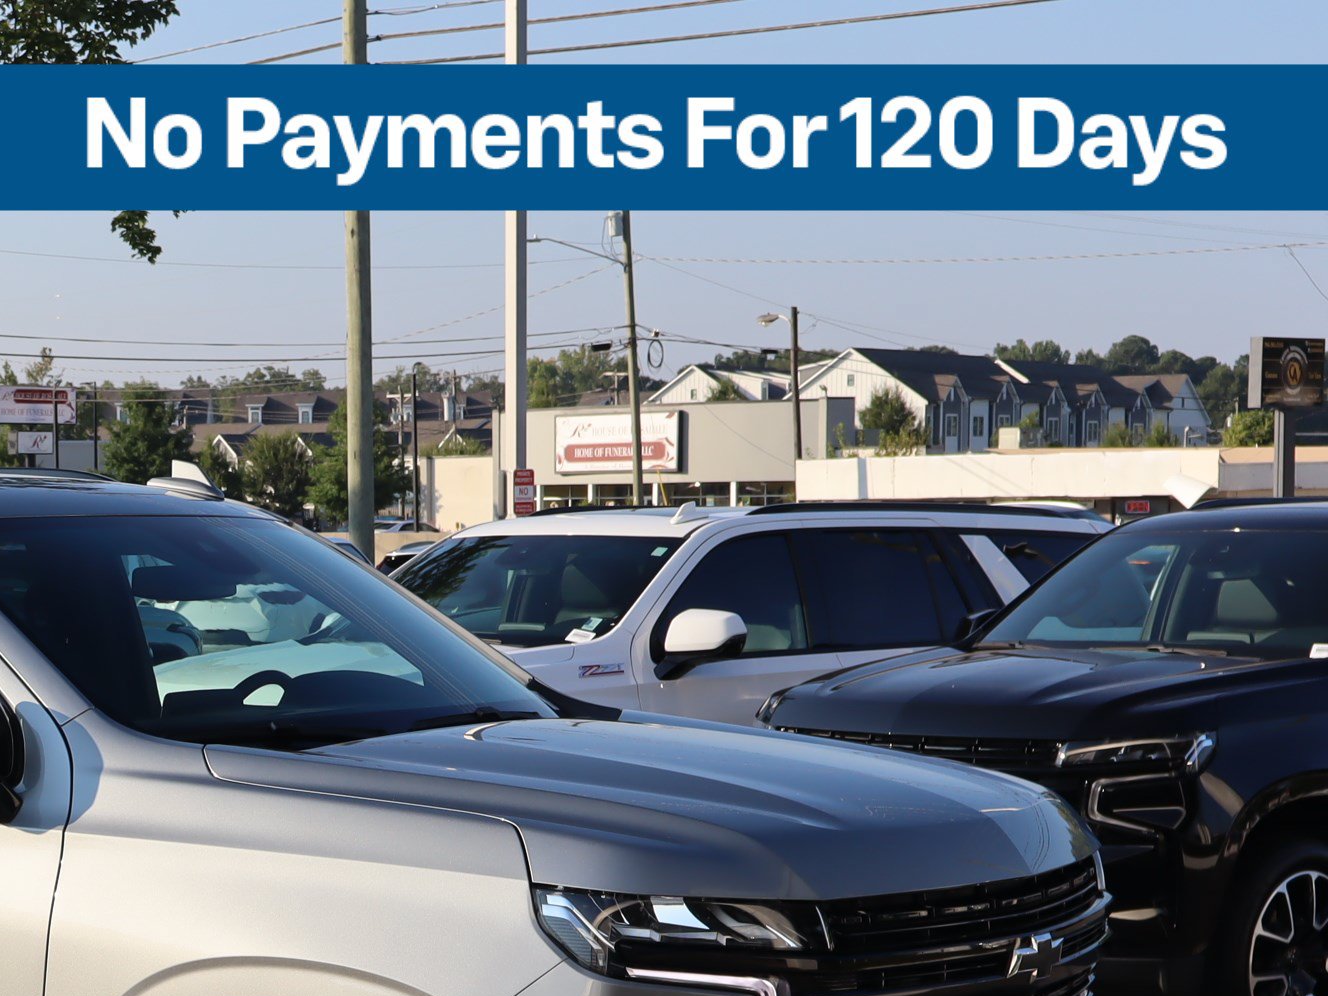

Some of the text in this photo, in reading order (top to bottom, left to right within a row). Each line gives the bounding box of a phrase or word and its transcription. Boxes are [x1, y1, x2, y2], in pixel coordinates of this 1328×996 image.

[574, 447, 594, 459] HOME
[594, 447, 604, 458] OF
[518, 487, 529, 496] NO
